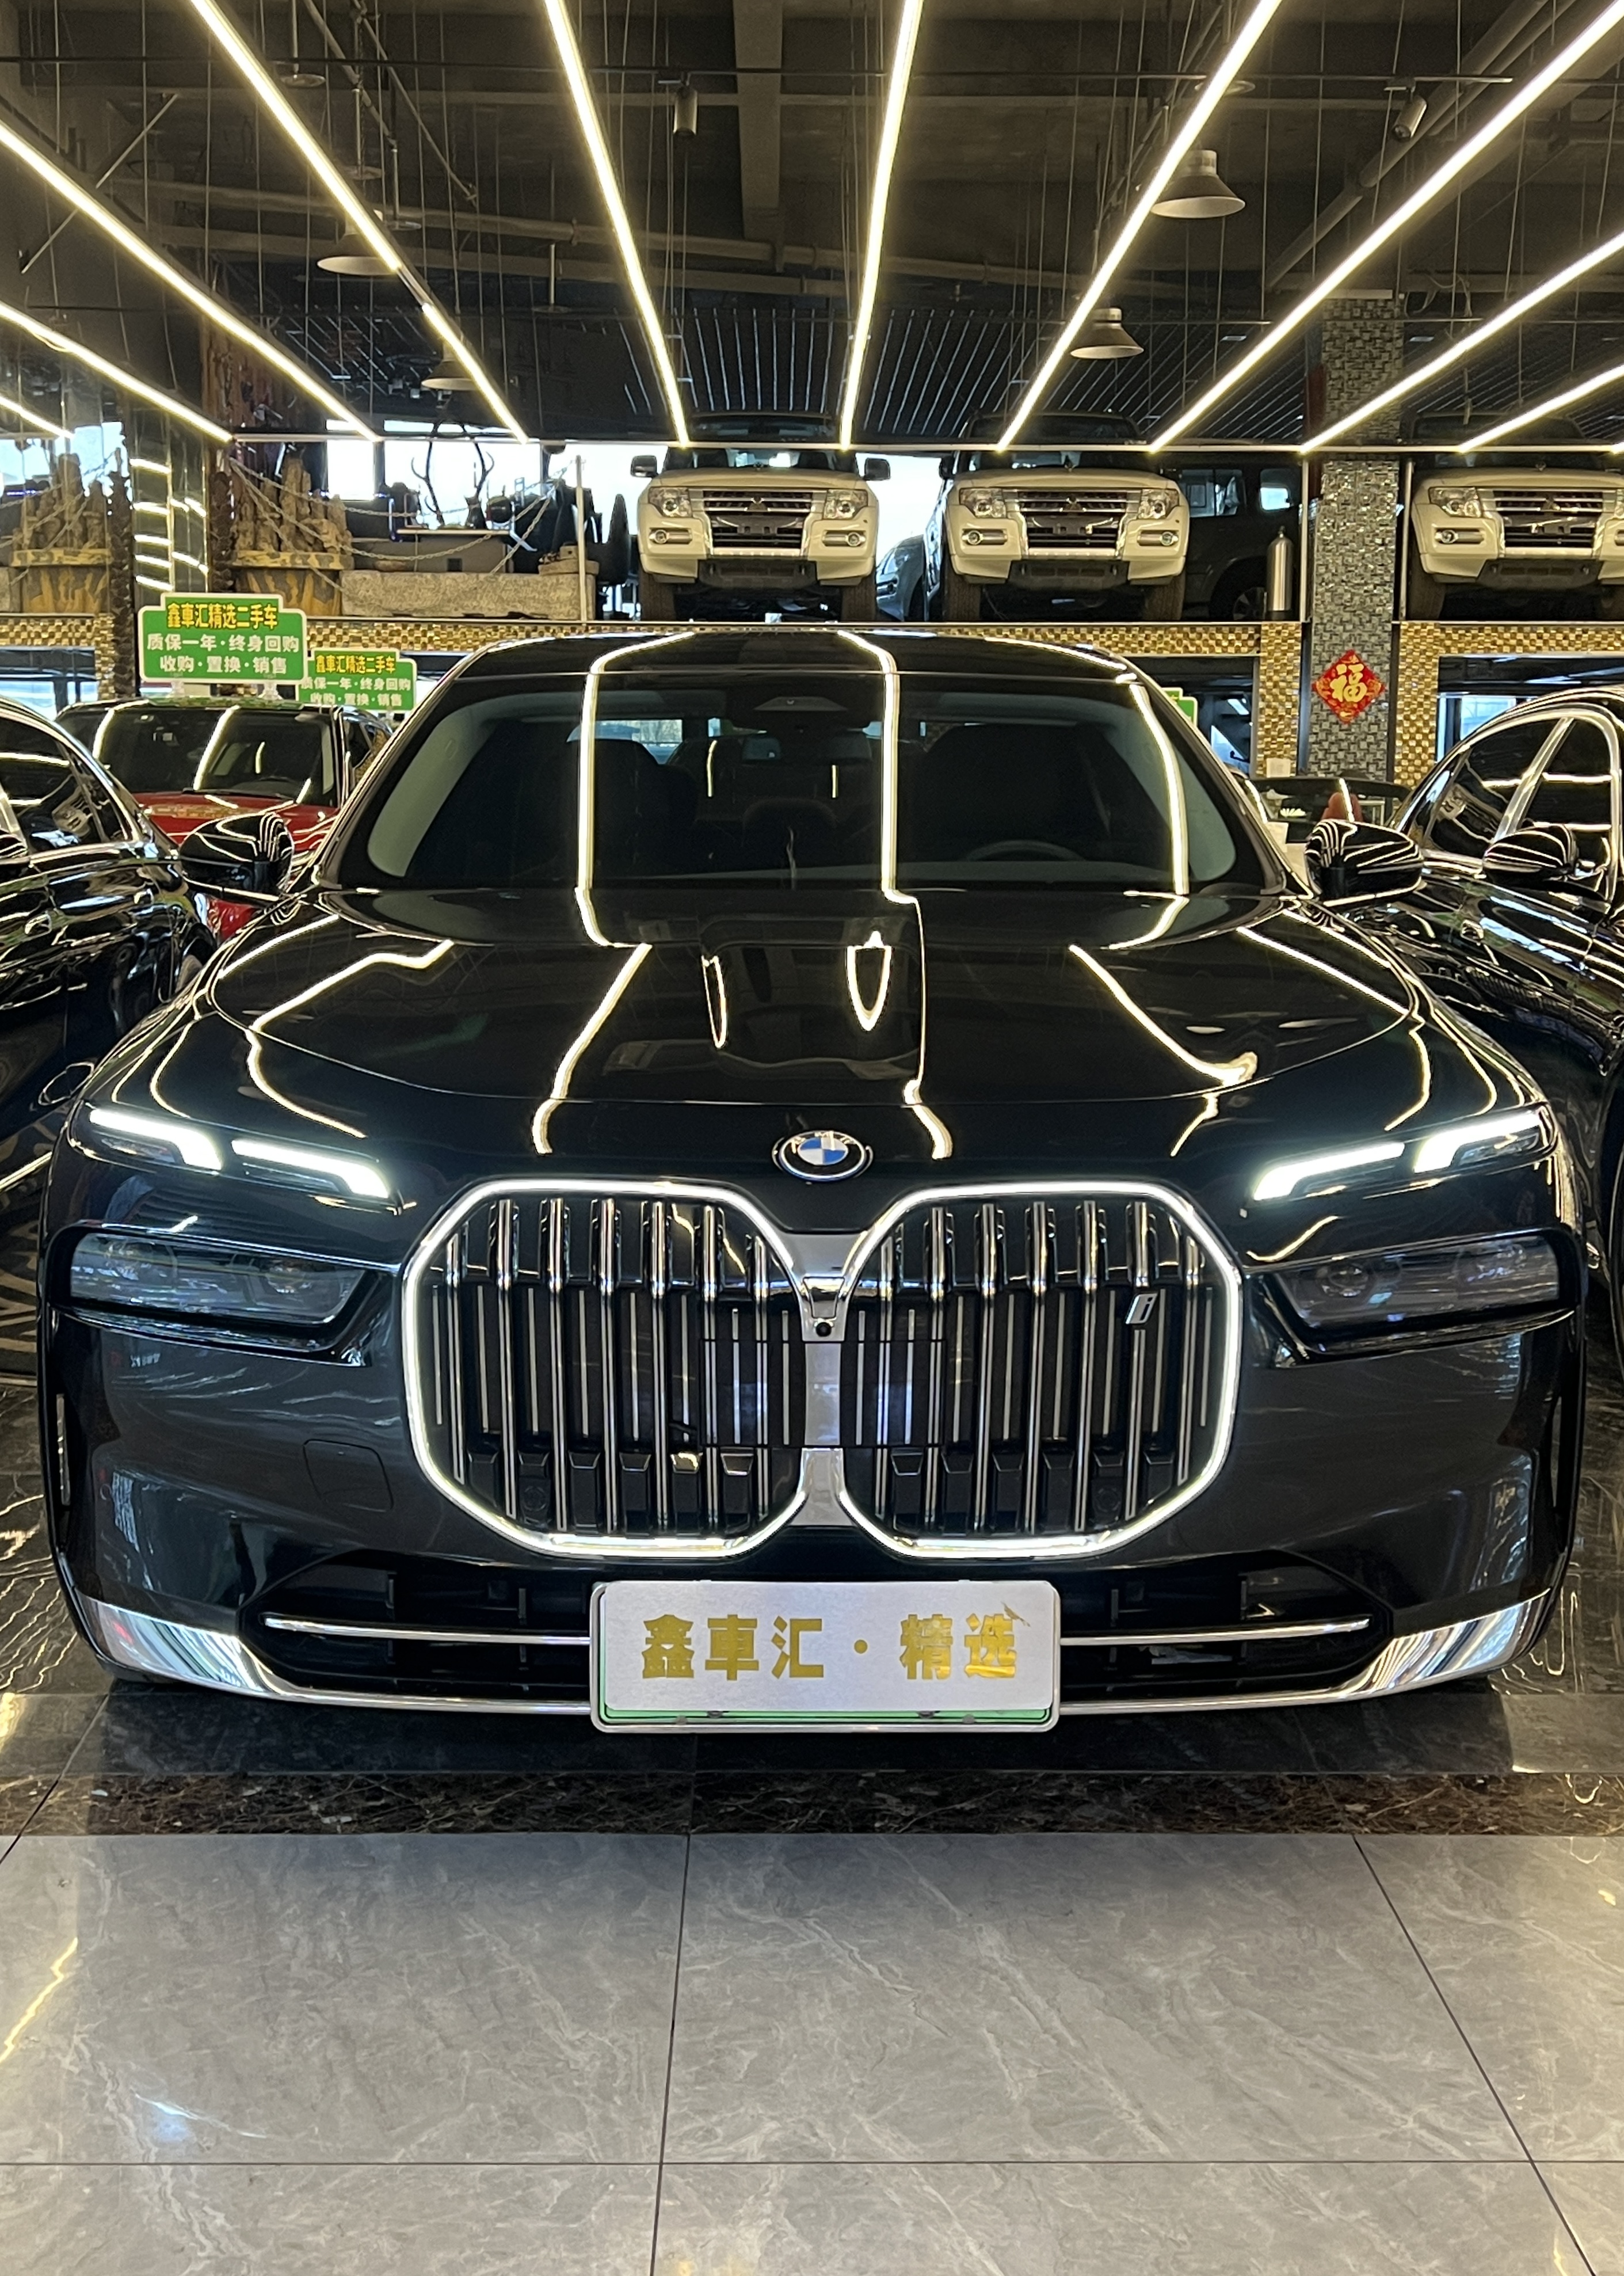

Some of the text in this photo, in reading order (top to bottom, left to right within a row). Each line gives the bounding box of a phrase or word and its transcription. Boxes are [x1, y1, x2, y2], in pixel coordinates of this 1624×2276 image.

[167, 602, 278, 629] 鑫車汇精选二手车
[1329, 663, 1368, 703] 福
